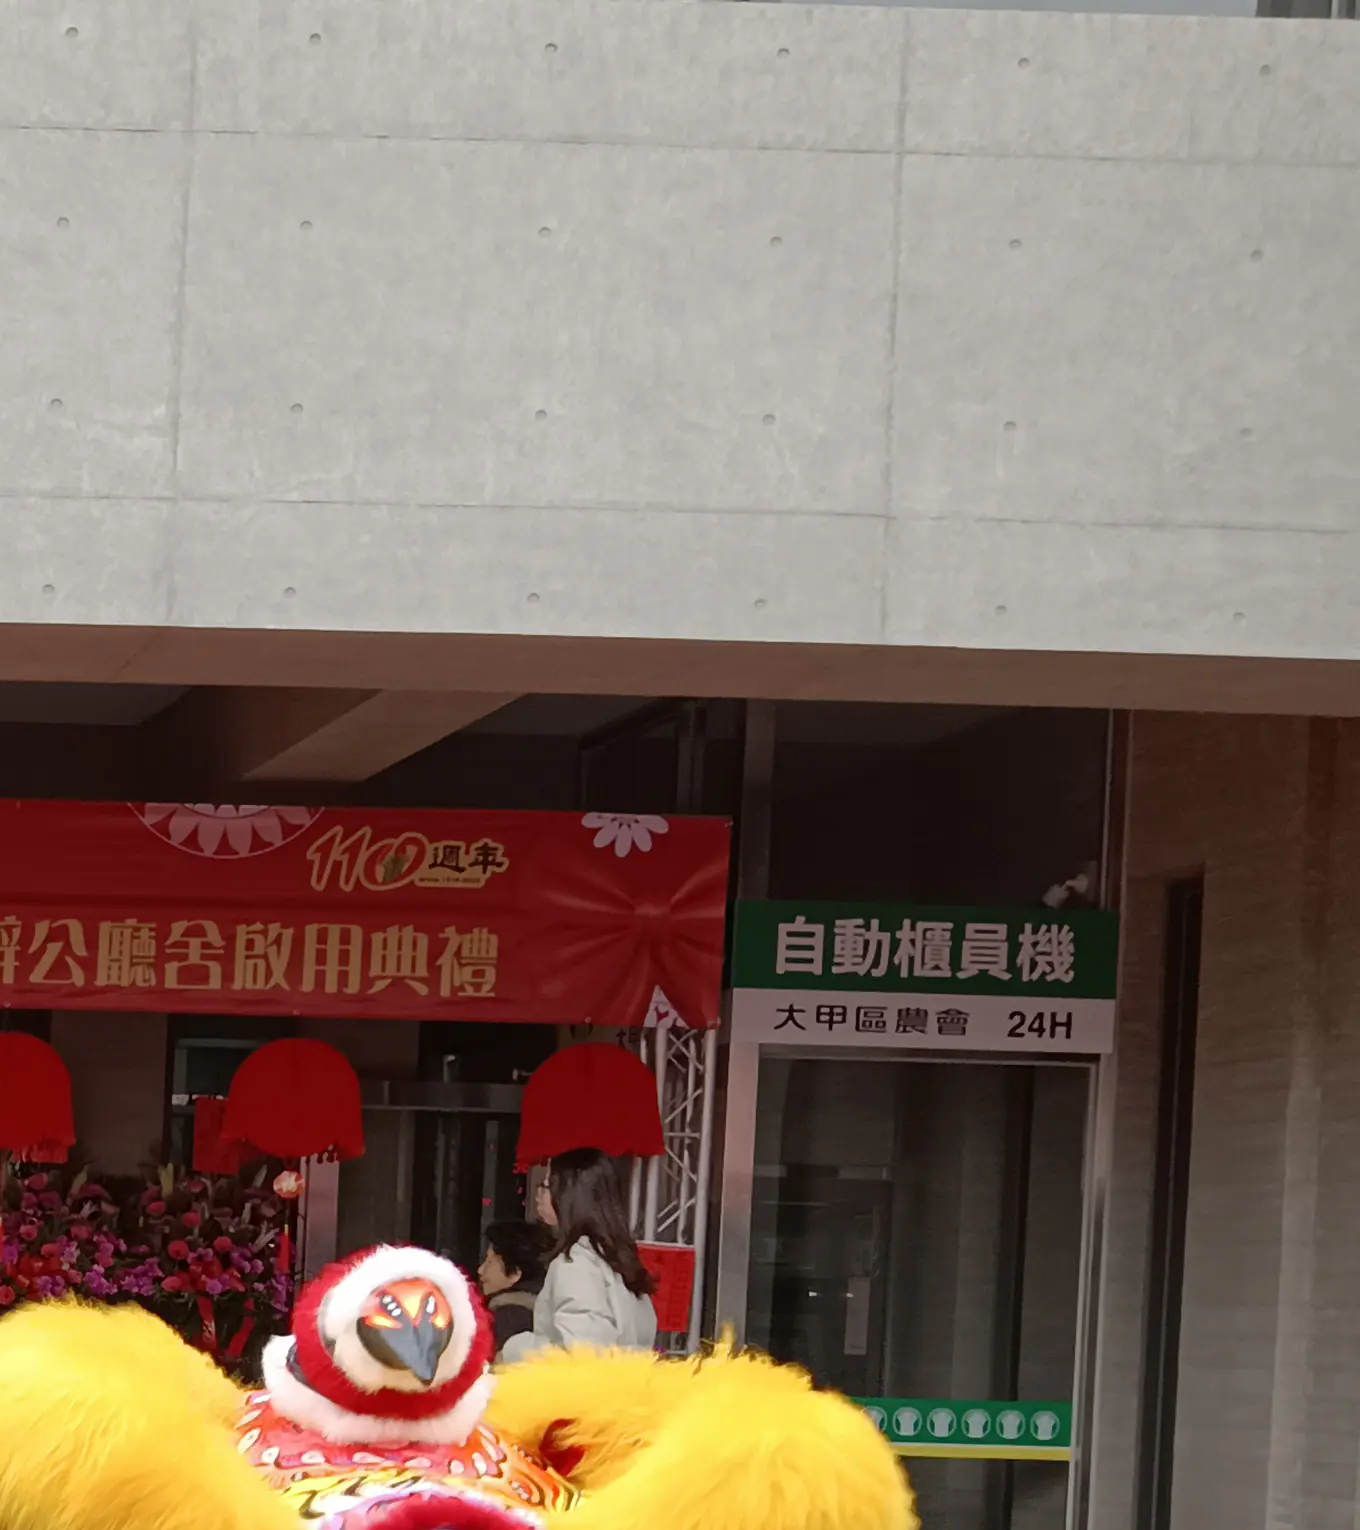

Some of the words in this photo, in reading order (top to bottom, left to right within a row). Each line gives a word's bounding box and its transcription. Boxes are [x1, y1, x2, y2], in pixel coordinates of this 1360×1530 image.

[775, 915, 1076, 983] 自動櫃員機
[773, 1003, 970, 1036] 大甲區農會
[1006, 1010, 1073, 1040] 24H
